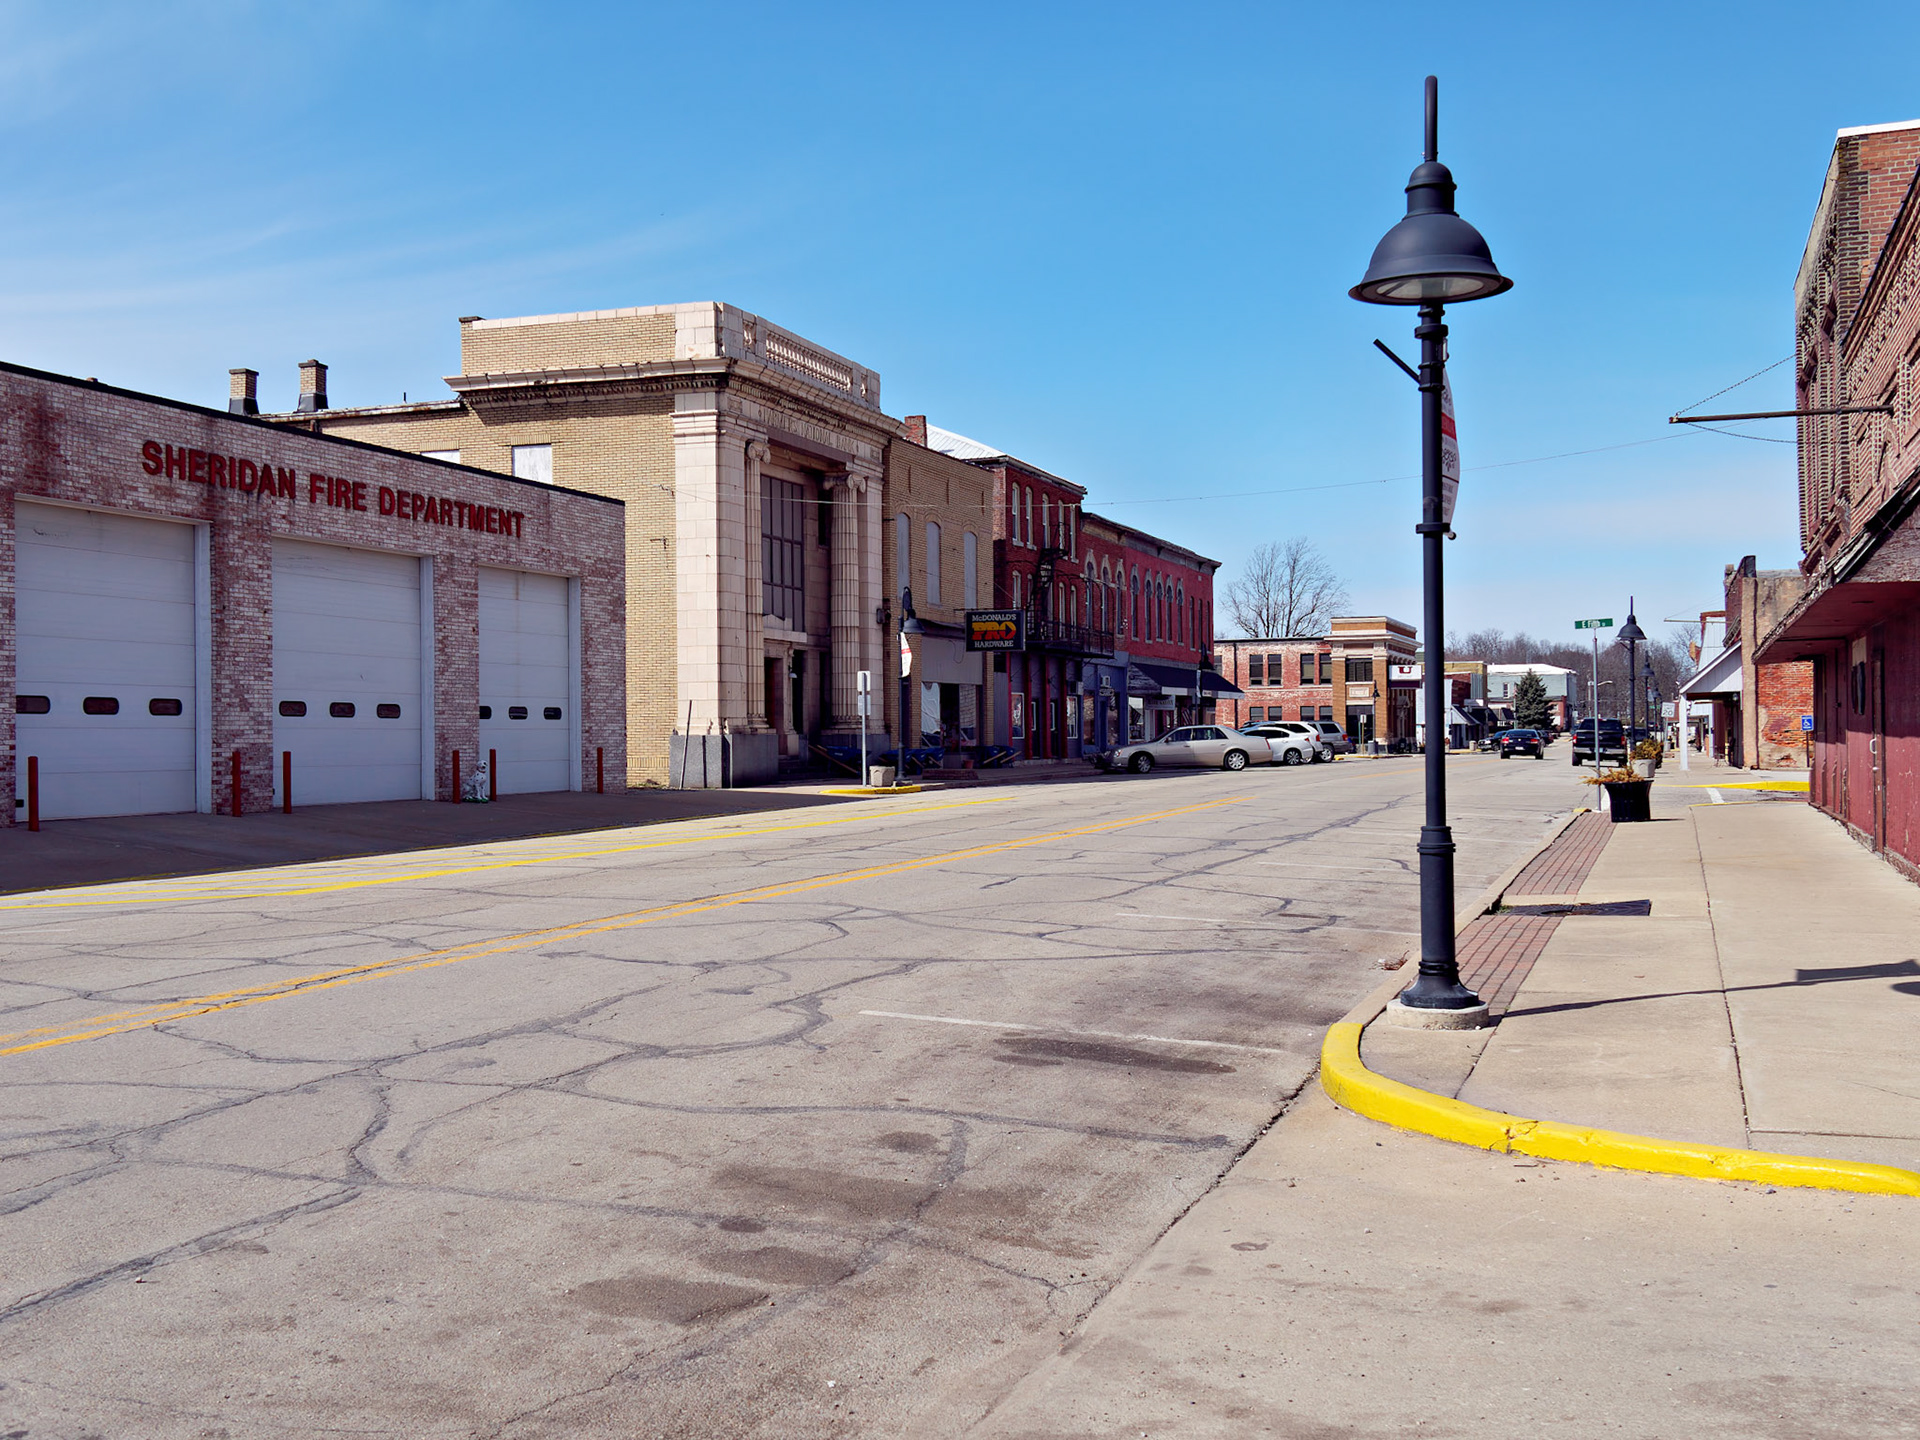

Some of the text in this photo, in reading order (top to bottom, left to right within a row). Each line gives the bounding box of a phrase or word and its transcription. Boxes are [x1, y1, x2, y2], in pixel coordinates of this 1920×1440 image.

[799, 421, 833, 446] NATIONAL
[142, 440, 524, 538] SHERIDAN FIRE DEPARTMENT
[971, 621, 1017, 640] PRO
[1582, 620, 1587, 629] E
[974, 640, 1014, 648] HARDWARE
[1398, 666, 1413, 674] U
